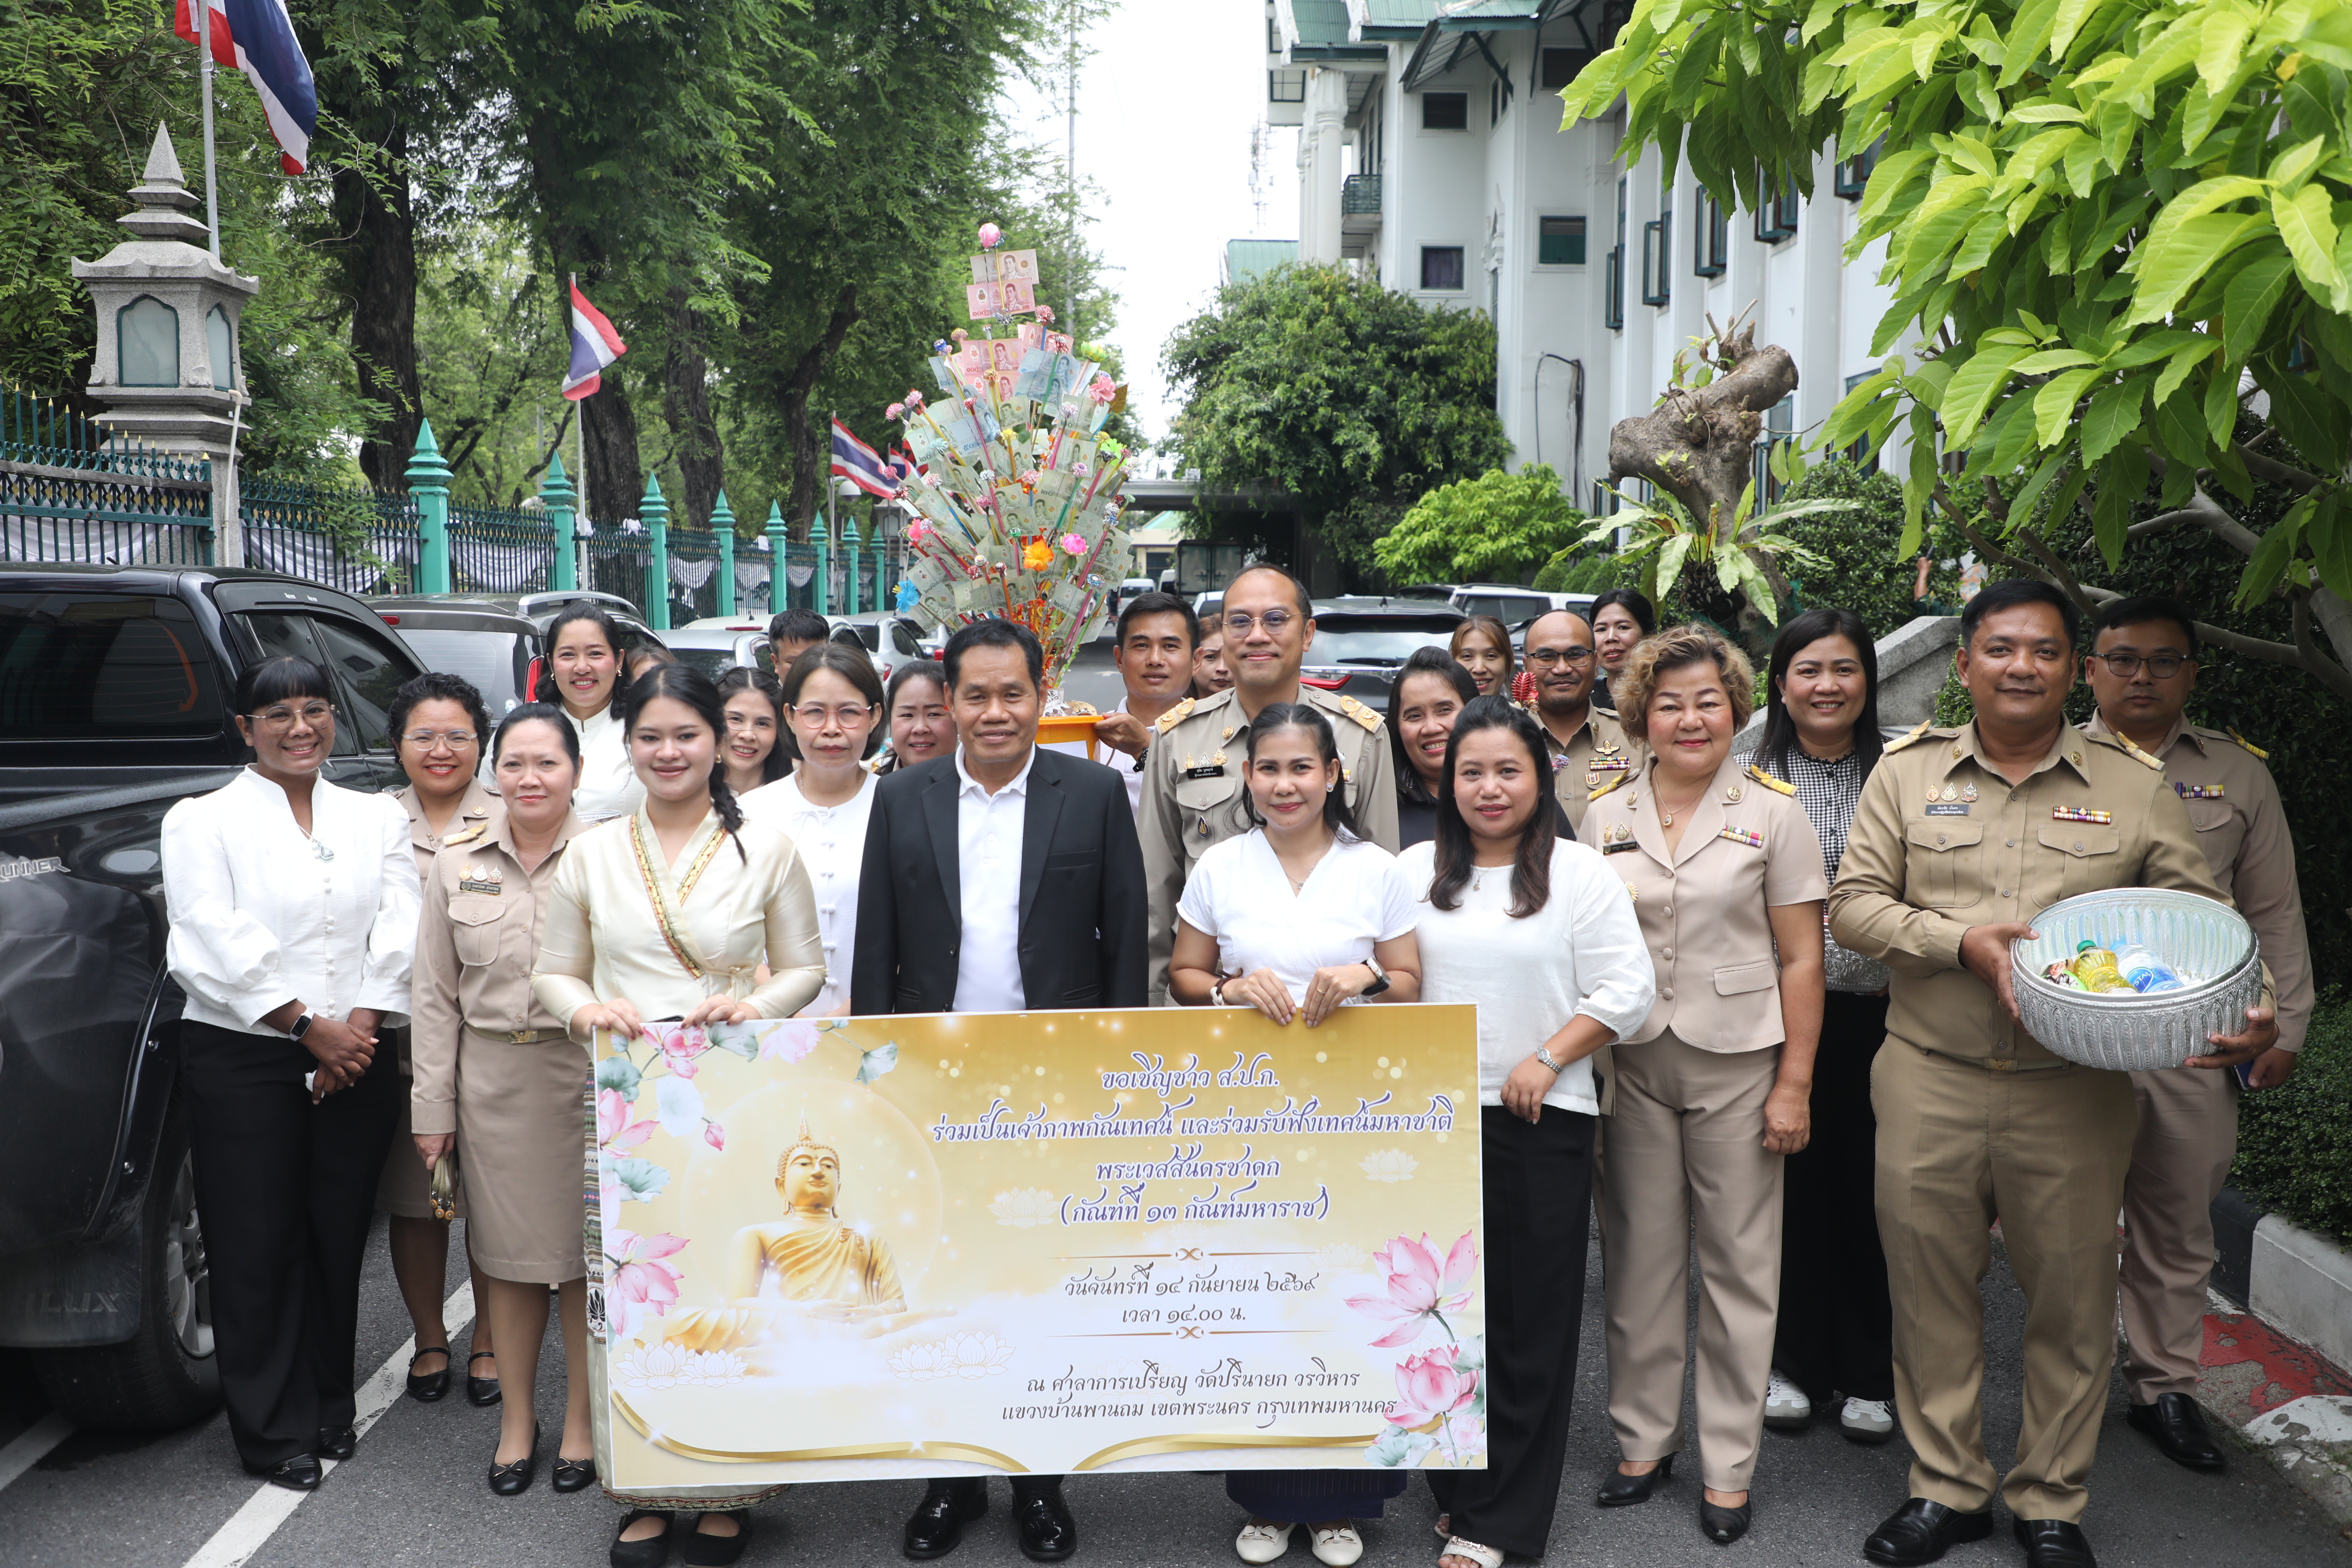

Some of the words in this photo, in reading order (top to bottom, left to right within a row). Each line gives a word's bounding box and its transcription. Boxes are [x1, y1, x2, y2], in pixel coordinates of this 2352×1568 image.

[0, 856, 72, 882] UNNER
[1102, 1052, 1211, 1097] ขอเชิญชาว
[1217, 1052, 1280, 1087] ส.ป.ก.
[1181, 1090, 1455, 1135] และร่วมรับฟังเทศน์มหาชาติ
[1096, 1140, 1281, 1181] พระเวสสันดรชาดก
[1144, 1205, 1178, 1224] ๑๓
[1154, 1276, 1184, 1296] ๑๔
[1188, 1264, 1259, 1293] กันยายน
[1263, 1271, 1320, 1292] ๒๕๖๙
[1122, 1308, 1160, 1323] เวลา
[1229, 1307, 1246, 1321] น.
[1027, 1379, 1045, 1392] ณ
[1052, 1359, 1188, 1396] ศาลาการเปรียญ
[1195, 1358, 1287, 1388] วัดปรินายก
[1294, 1356, 1360, 1387] วรวิหาร
[1002, 1390, 1144, 1420] แขวงบ้านพานถม
[1151, 1402, 1251, 1416] เขตพระนคร
[1256, 1399, 1397, 1429] กรุงเทพมหานคร
